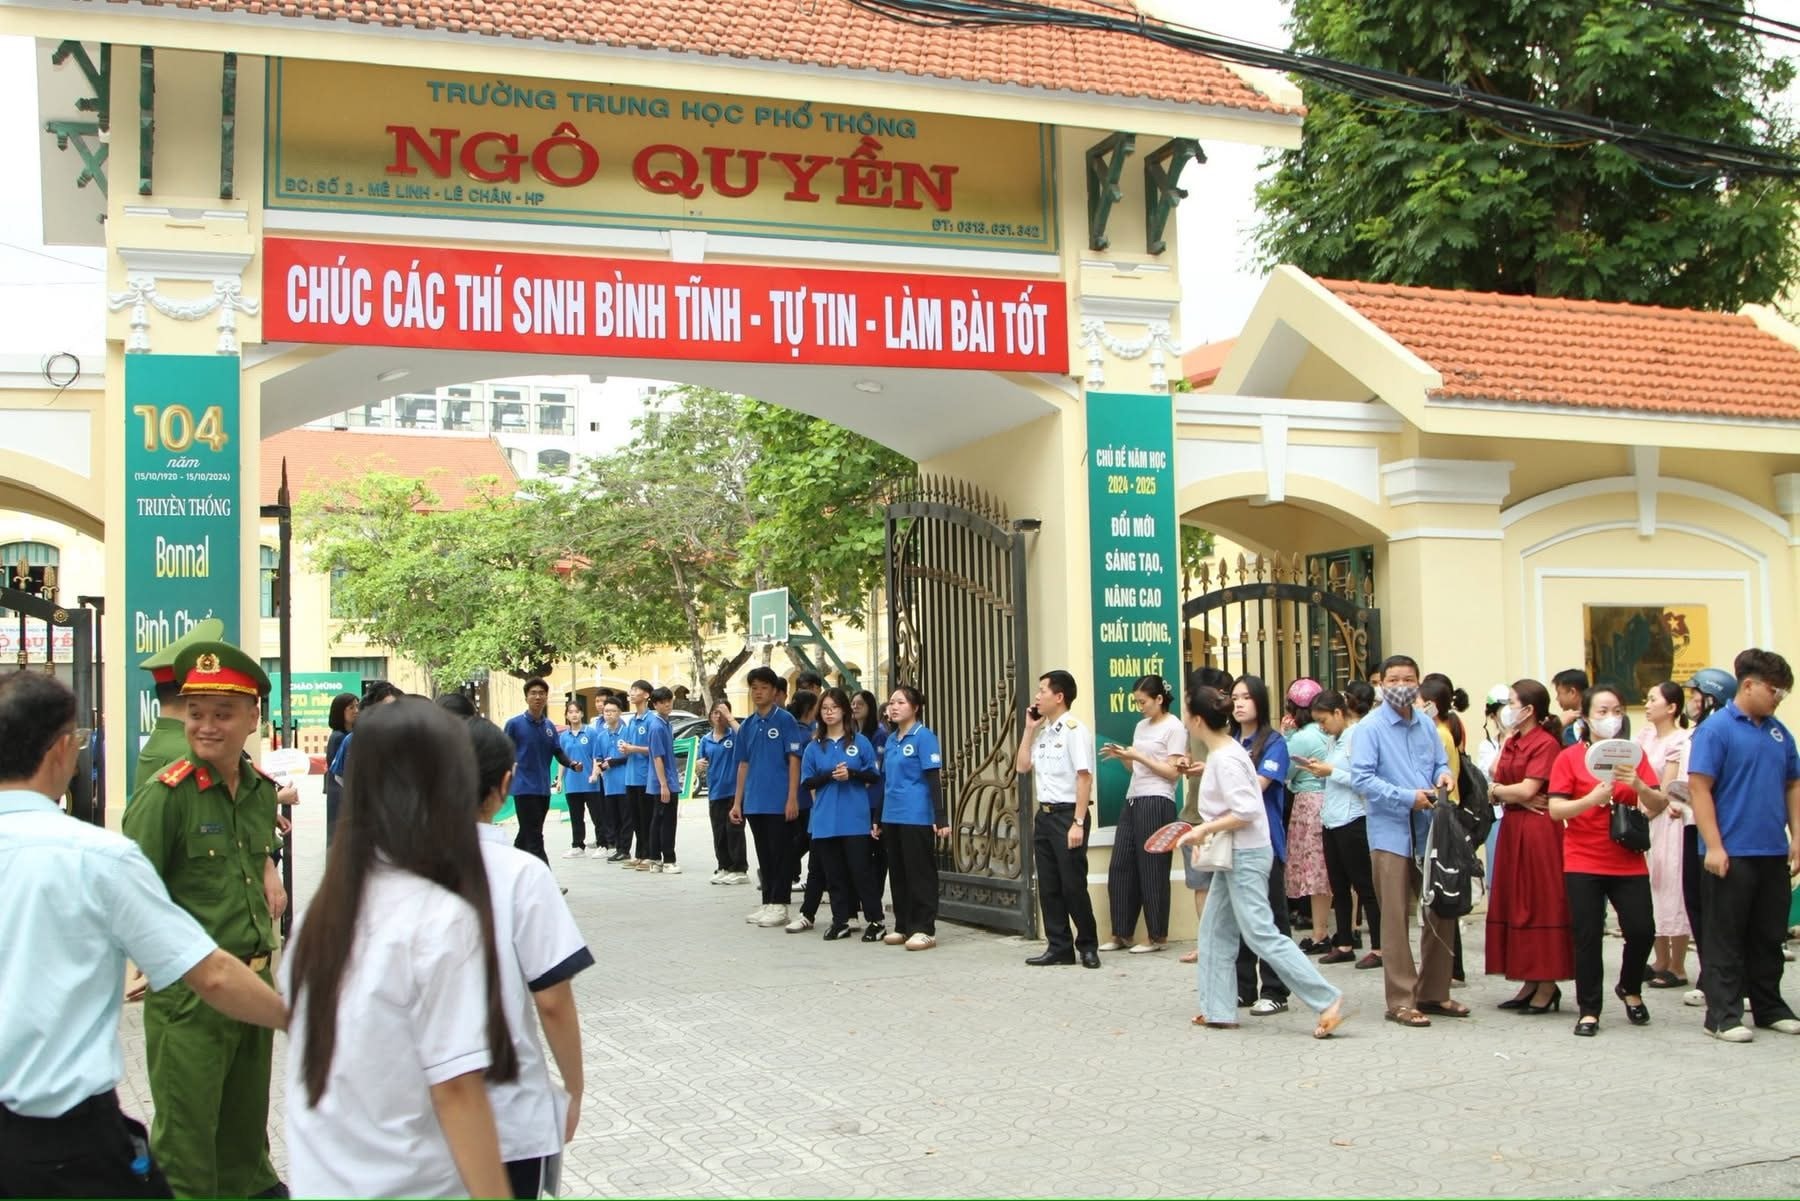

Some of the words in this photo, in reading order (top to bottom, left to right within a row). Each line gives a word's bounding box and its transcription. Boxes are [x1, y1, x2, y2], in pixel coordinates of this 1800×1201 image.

[427, 79, 557, 111] TRƯỜNG
[567, 92, 669, 118] TRUNG
[682, 100, 744, 128] HỌC
[755, 101, 814, 129] PHỔ
[821, 111, 918, 139] THÔNG
[385, 120, 600, 188] NGÔ
[632, 135, 960, 213] QUYỀN
[344, 183, 354, 195] 2
[367, 181, 391, 197] MÊ
[396, 185, 431, 200] LINH
[444, 184, 464, 201] LÊ
[468, 186, 512, 204] CHÂN
[524, 192, 545, 206] HP
[286, 255, 372, 326] CHÚC
[383, 259, 445, 330] CÁC
[455, 264, 503, 333] THÍ
[512, 276, 585, 336] SINH
[595, 270, 666, 339] BÌNH
[674, 275, 741, 342] TĨNH
[769, 286, 807, 358] TỰ
[812, 292, 858, 347] TIN
[884, 285, 943, 352] LÀM
[951, 288, 995, 353] BÀI
[1002, 284, 1048, 356] TỐT
[132, 404, 229, 452] 104
[166, 456, 200, 469] năm
[1096, 443, 1113, 467] CHỦ
[1128, 447, 1148, 468] NĂM
[1149, 451, 1166, 473] HỌC
[1108, 475, 1129, 494] 2024
[1136, 476, 1156, 494] 2025
[137, 493, 186, 516] TRUYỀN
[188, 493, 231, 516] THỐNG
[1111, 509, 1130, 537] ĐỔI
[1133, 513, 1155, 538] MỚI
[156, 535, 209, 578] Bonnal
[1105, 547, 1136, 571] SÁNG
[1139, 552, 1163, 577] TẠO,
[1105, 584, 1136, 608] NÂNG
[1139, 588, 1162, 608] CAO
[135, 610, 170, 653] Bình
[1100, 616, 1129, 642] CHẤT
[1132, 621, 1172, 647] LƯỢNG,
[1109, 654, 1140, 678] ĐOÀN
[1143, 652, 1164, 676] KẾT
[1110, 686, 1125, 713] KỶ
